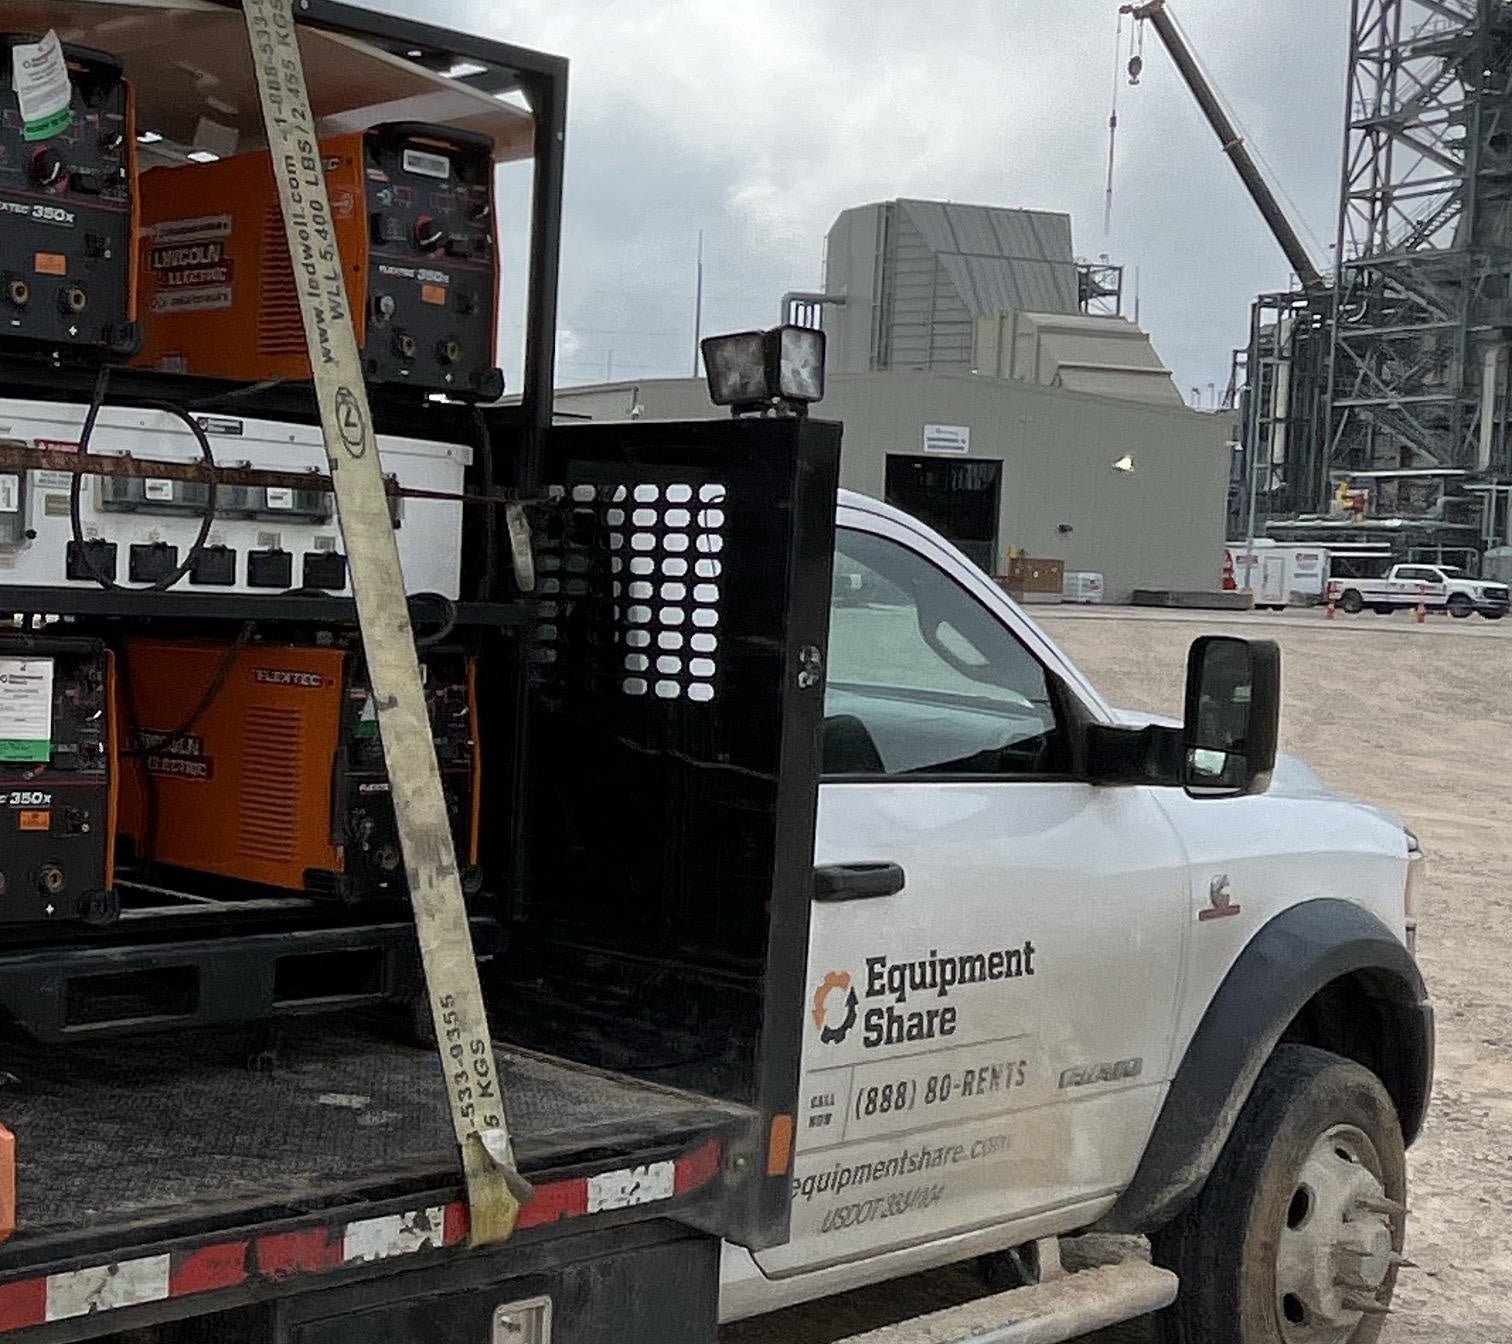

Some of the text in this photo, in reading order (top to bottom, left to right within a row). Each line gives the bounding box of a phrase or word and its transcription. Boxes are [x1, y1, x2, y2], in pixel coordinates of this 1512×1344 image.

[297, 139, 319, 188] LBS
[152, 243, 221, 268] LINCOLN
[324, 267, 346, 322] WLL
[256, 669, 322, 686] FLEXTEC
[864, 940, 1036, 1003] Equipment
[863, 1005, 958, 1049] Share
[470, 1039, 494, 1099] KGS
[855, 1079, 917, 1121] (888)
[924, 1060, 1028, 1105] 80-RENTS
[808, 1113, 833, 1128] NOW
[810, 1093, 836, 1109] CALL
[792, 1134, 1011, 1202] equipmentshare.com
